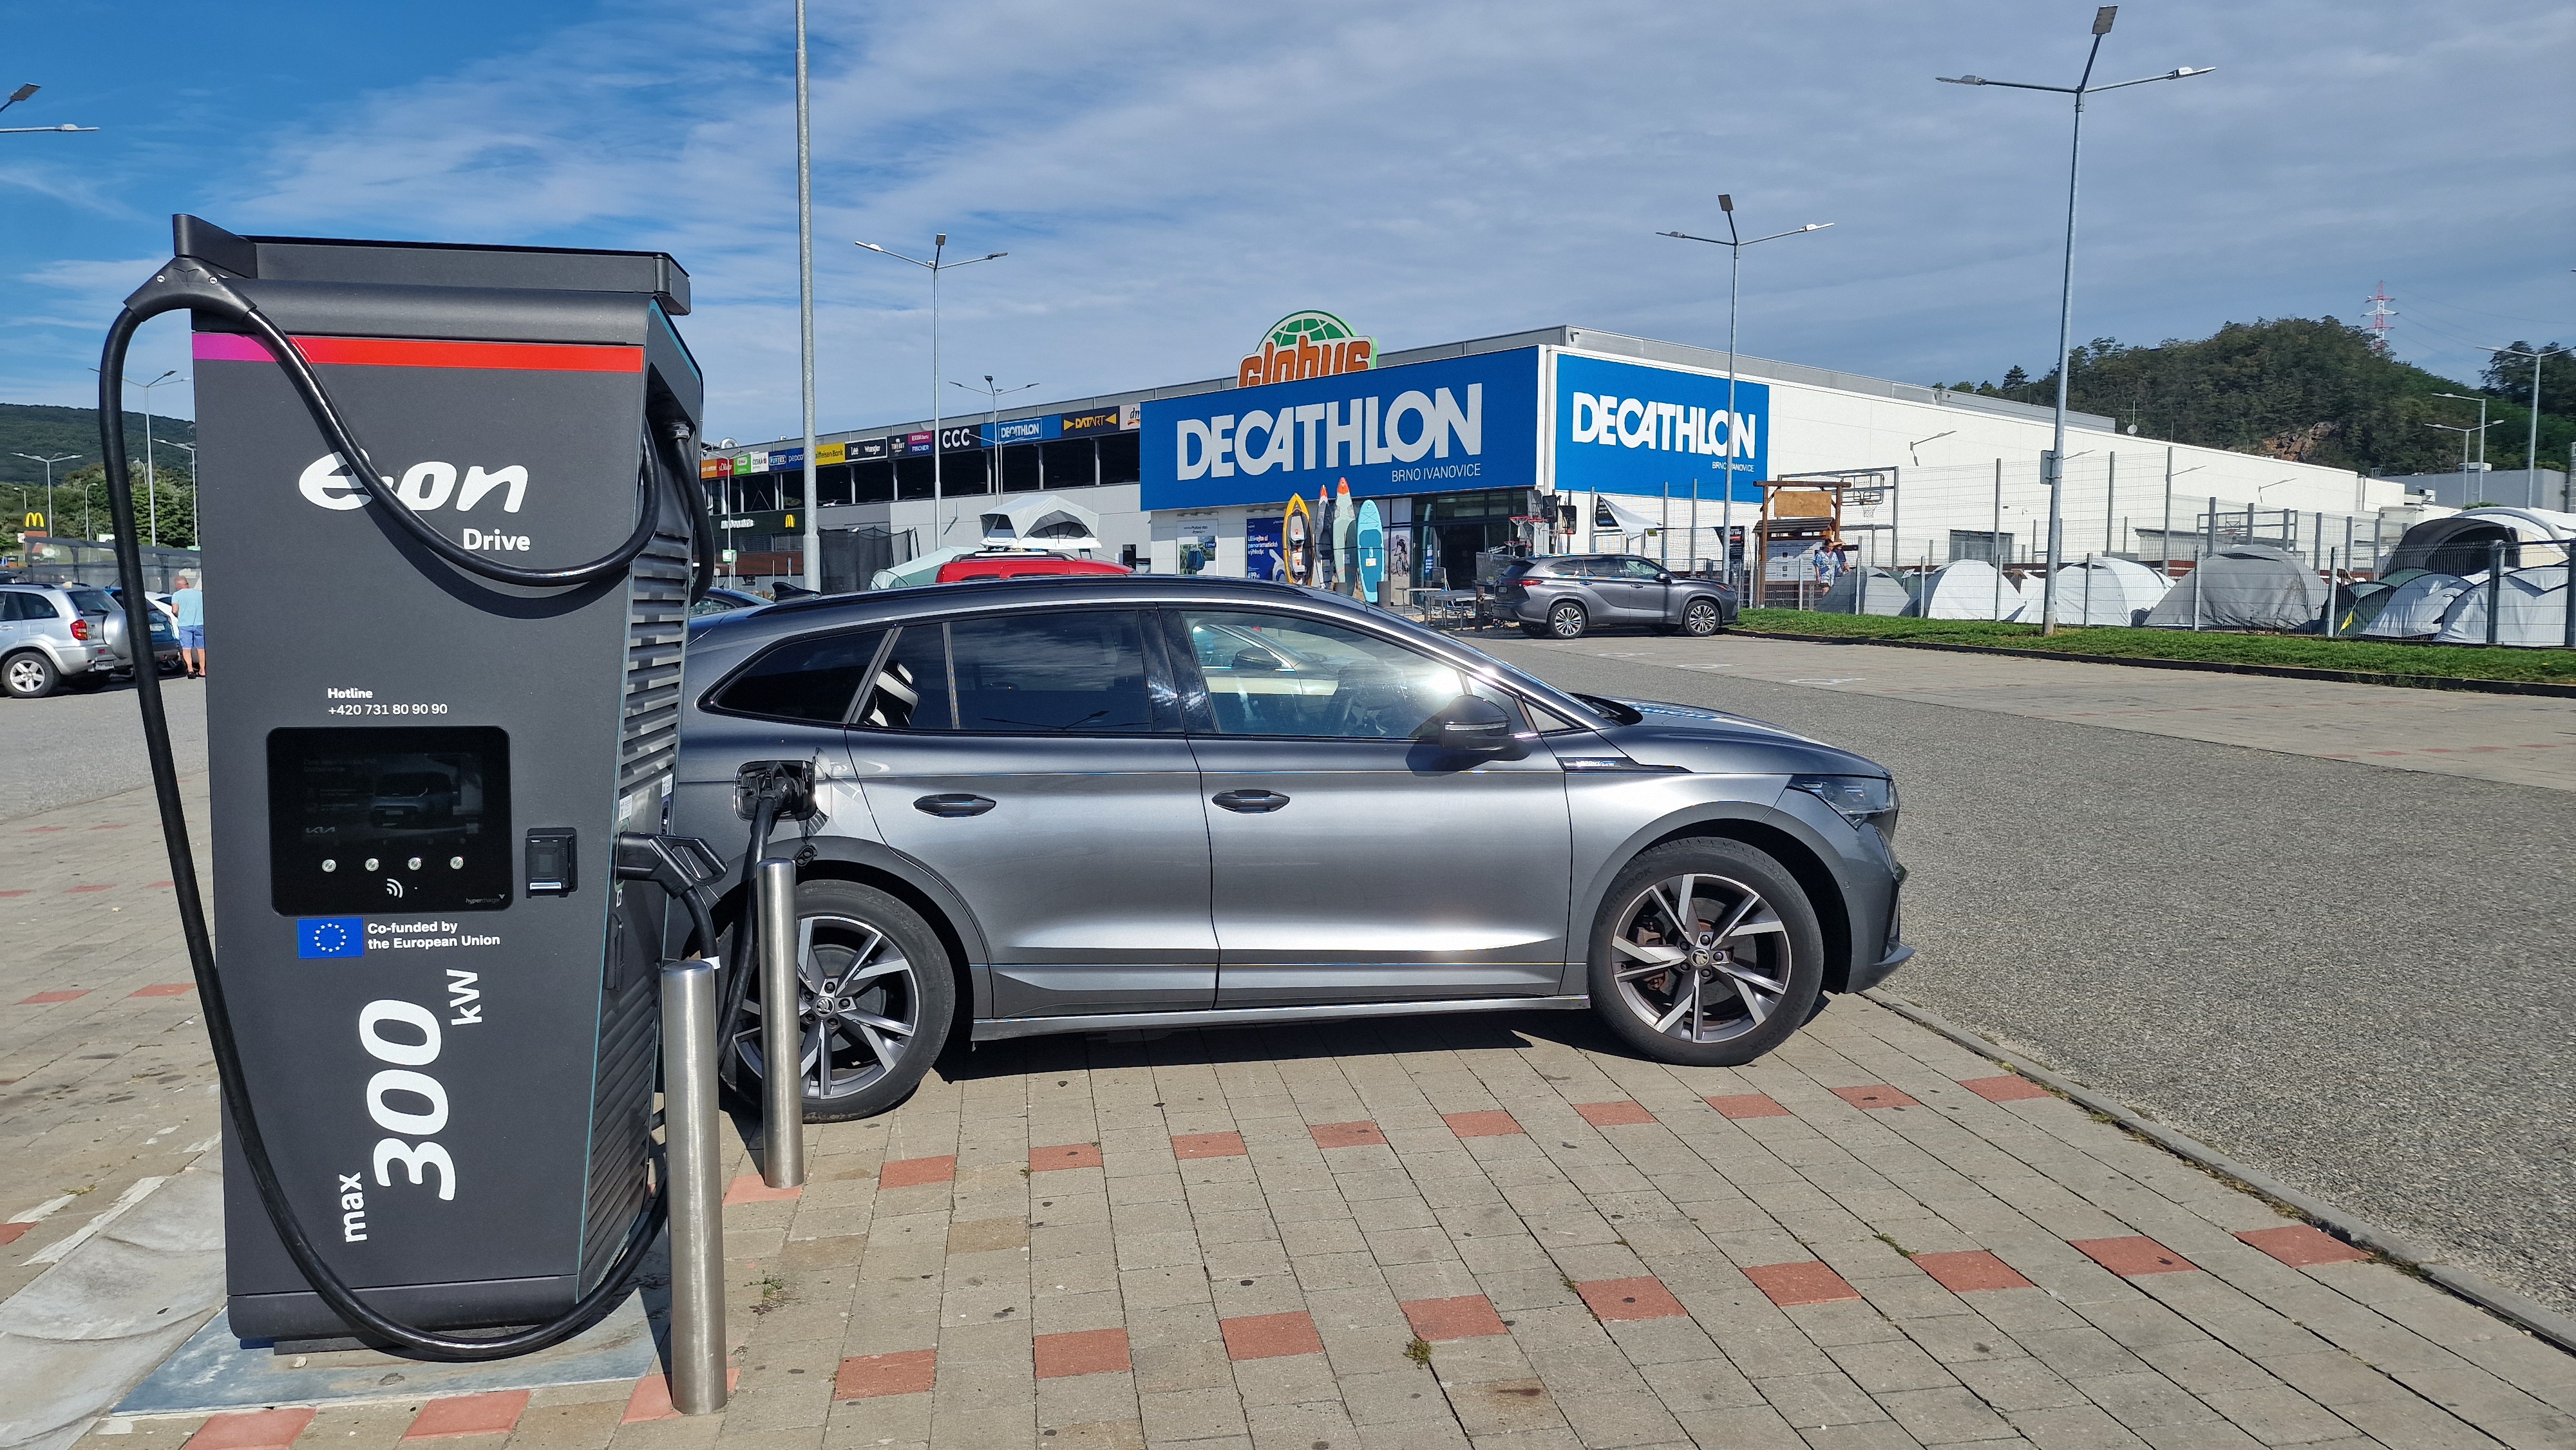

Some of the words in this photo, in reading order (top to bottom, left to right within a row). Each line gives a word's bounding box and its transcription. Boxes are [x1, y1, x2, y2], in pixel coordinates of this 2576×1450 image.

[1001, 423, 1039, 438] DECATHLON
[1075, 415, 1106, 429] DATART
[1572, 391, 1756, 459] DECATHLON
[942, 428, 970, 448] CCC
[1177, 383, 1482, 481] DECATHLON
[1392, 466, 1421, 482] BRNO
[1423, 463, 1481, 480] IVANOVICE
[463, 527, 531, 551] Drive
[327, 688, 374, 699] Hotline
[328, 704, 362, 716] +420
[365, 704, 390, 715] 731
[392, 704, 409, 715] 80
[412, 704, 429, 715] 90
[431, 703, 448, 715] 90
[367, 921, 439, 936] Co-funded
[441, 921, 458, 934] by
[368, 938, 390, 950] the
[393, 937, 457, 950] European
[461, 935, 500, 946] Union
[338, 1171, 368, 1243] max
[359, 999, 456, 1201] 300
[446, 968, 482, 1026] kW
